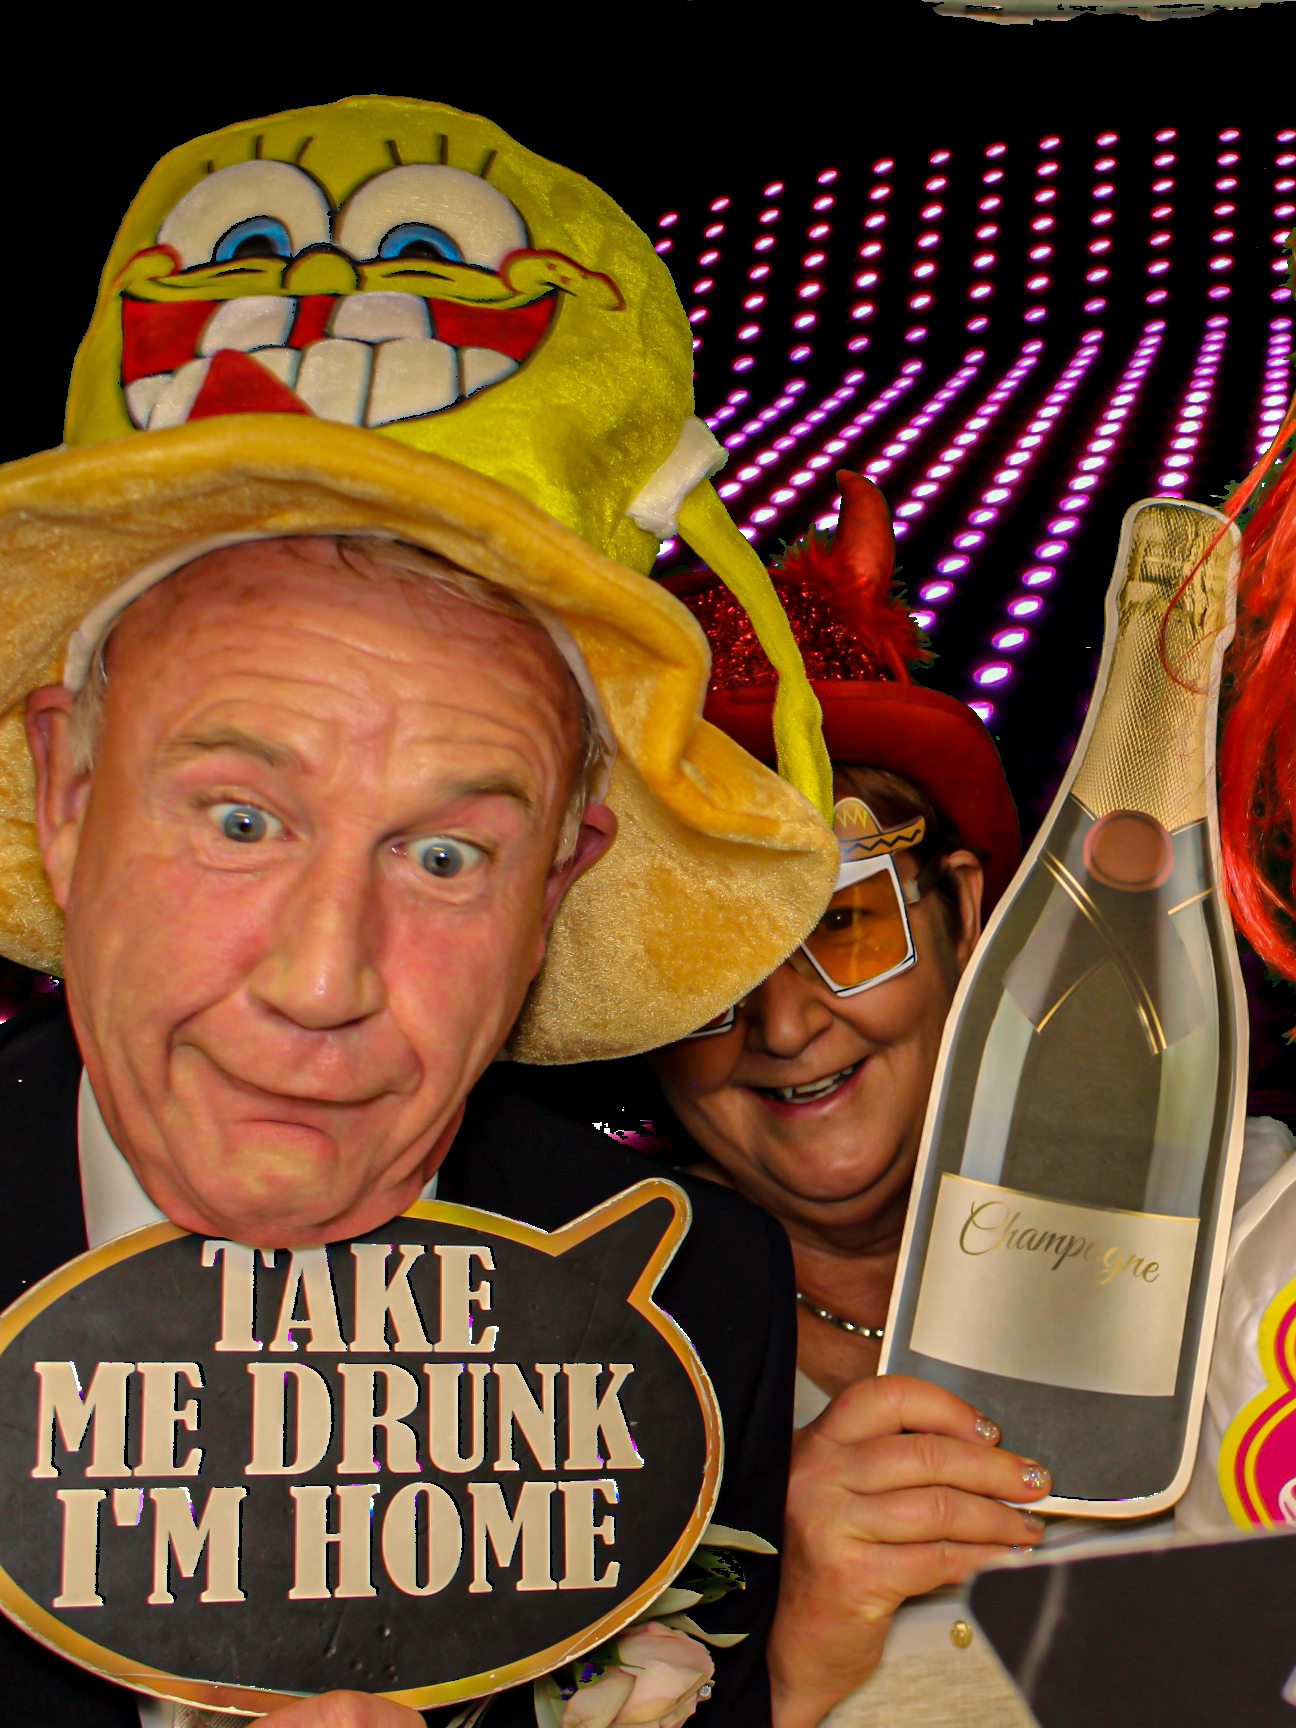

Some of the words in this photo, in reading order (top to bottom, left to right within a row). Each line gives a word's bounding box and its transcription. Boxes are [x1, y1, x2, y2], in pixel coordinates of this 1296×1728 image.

[202, 1240, 500, 1353] TAKE
[959, 1201, 1161, 1285] Champagne
[31, 1361, 206, 1478] ME
[245, 1362, 645, 1475] DRUNK
[53, 1486, 251, 1608] I'M
[288, 1478, 622, 1600] HOME
